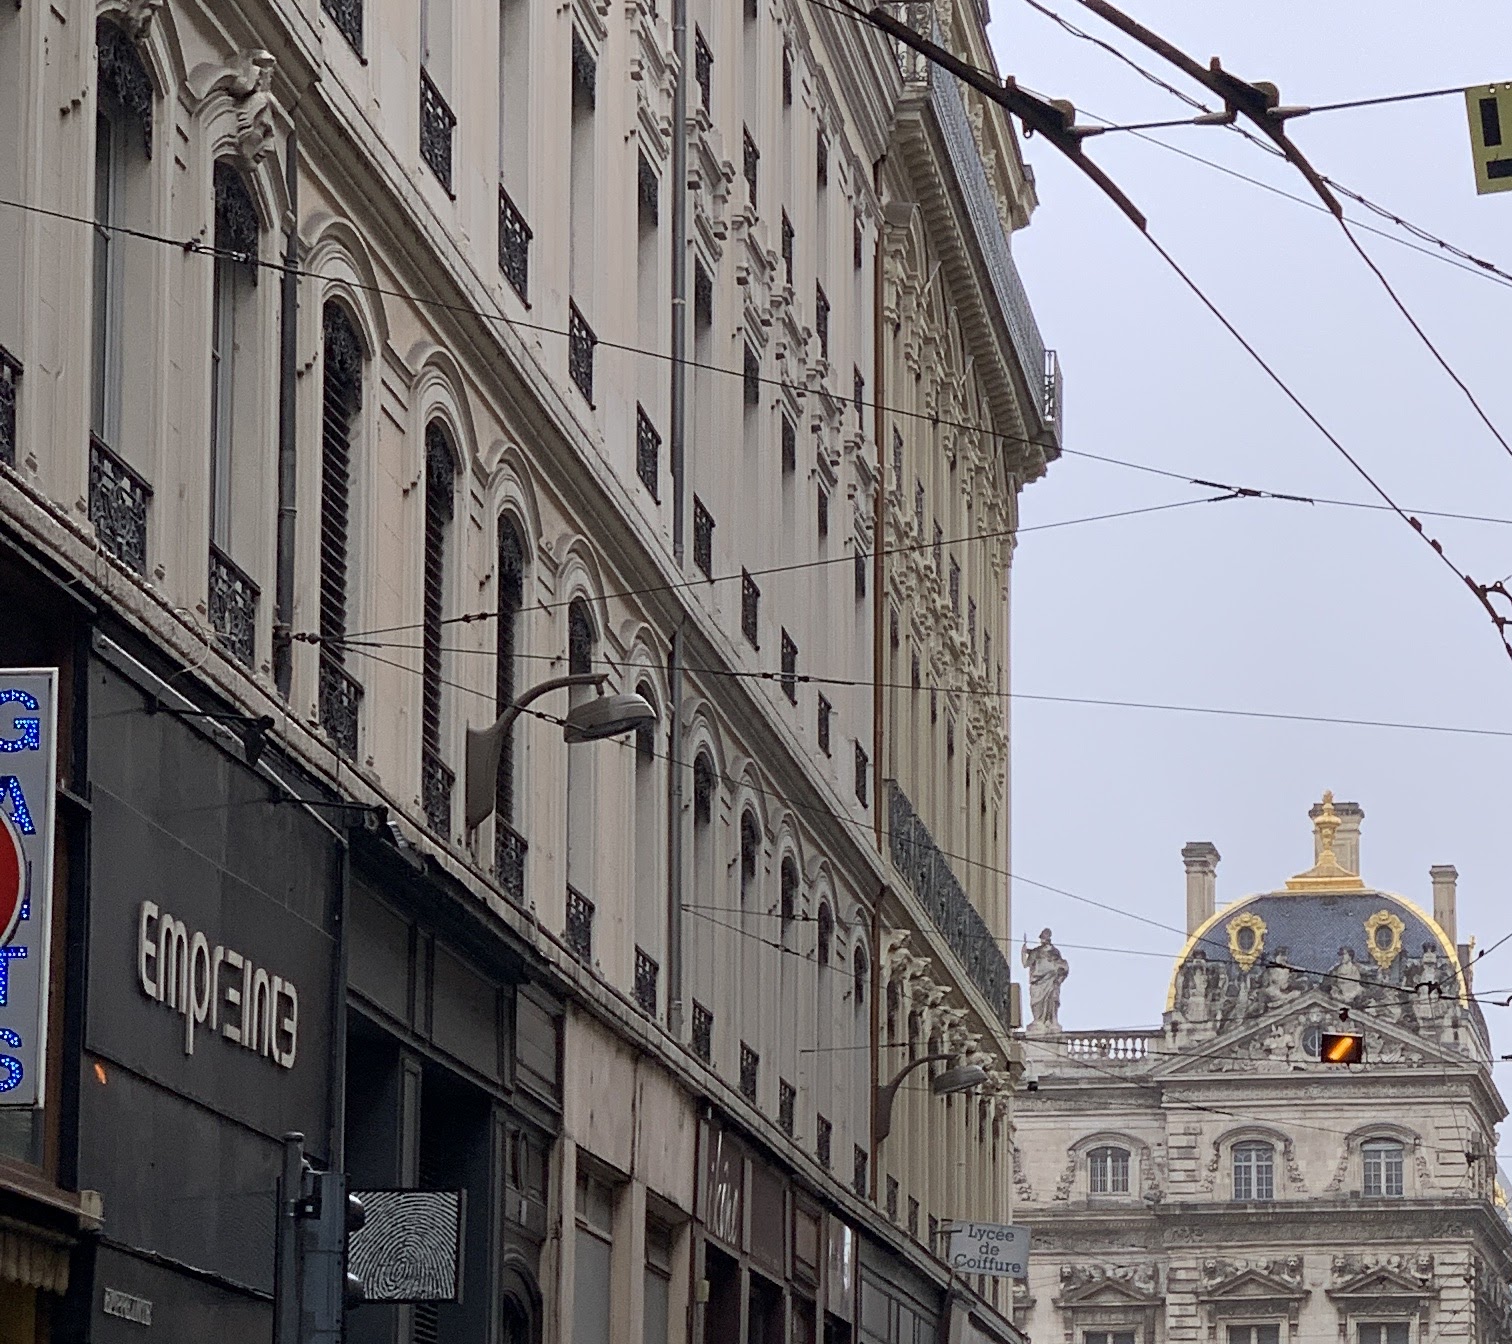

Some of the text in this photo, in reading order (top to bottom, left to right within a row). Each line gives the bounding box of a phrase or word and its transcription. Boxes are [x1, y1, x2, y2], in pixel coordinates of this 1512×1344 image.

[0, 689, 40, 1093] GATS
[979, 1242, 999, 1256] de
[953, 1254, 1021, 1273] Coiffure
